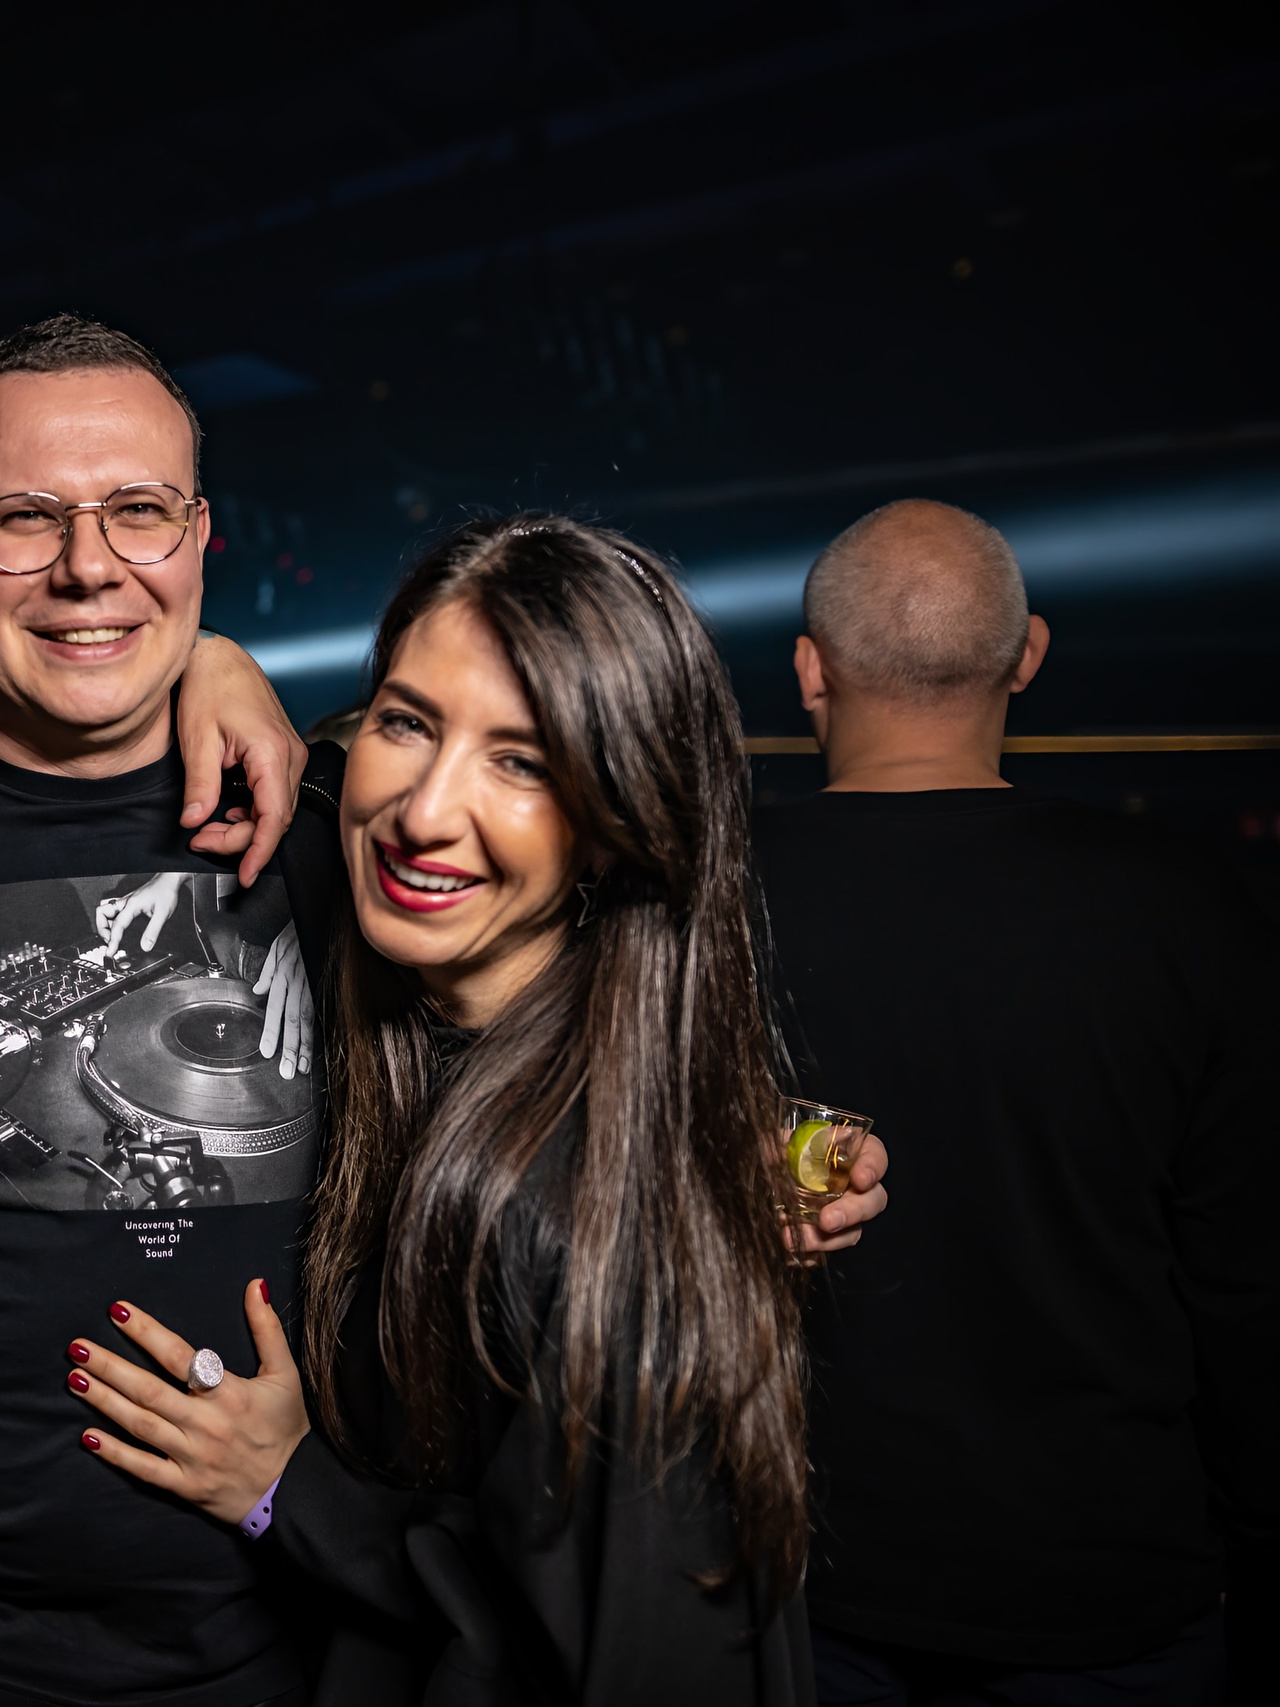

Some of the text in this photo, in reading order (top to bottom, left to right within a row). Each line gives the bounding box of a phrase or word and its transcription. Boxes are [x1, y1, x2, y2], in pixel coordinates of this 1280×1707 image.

[125, 1218, 194, 1231] Uncovering The
[138, 1234, 180, 1244] World Of
[145, 1248, 173, 1258] Sound
